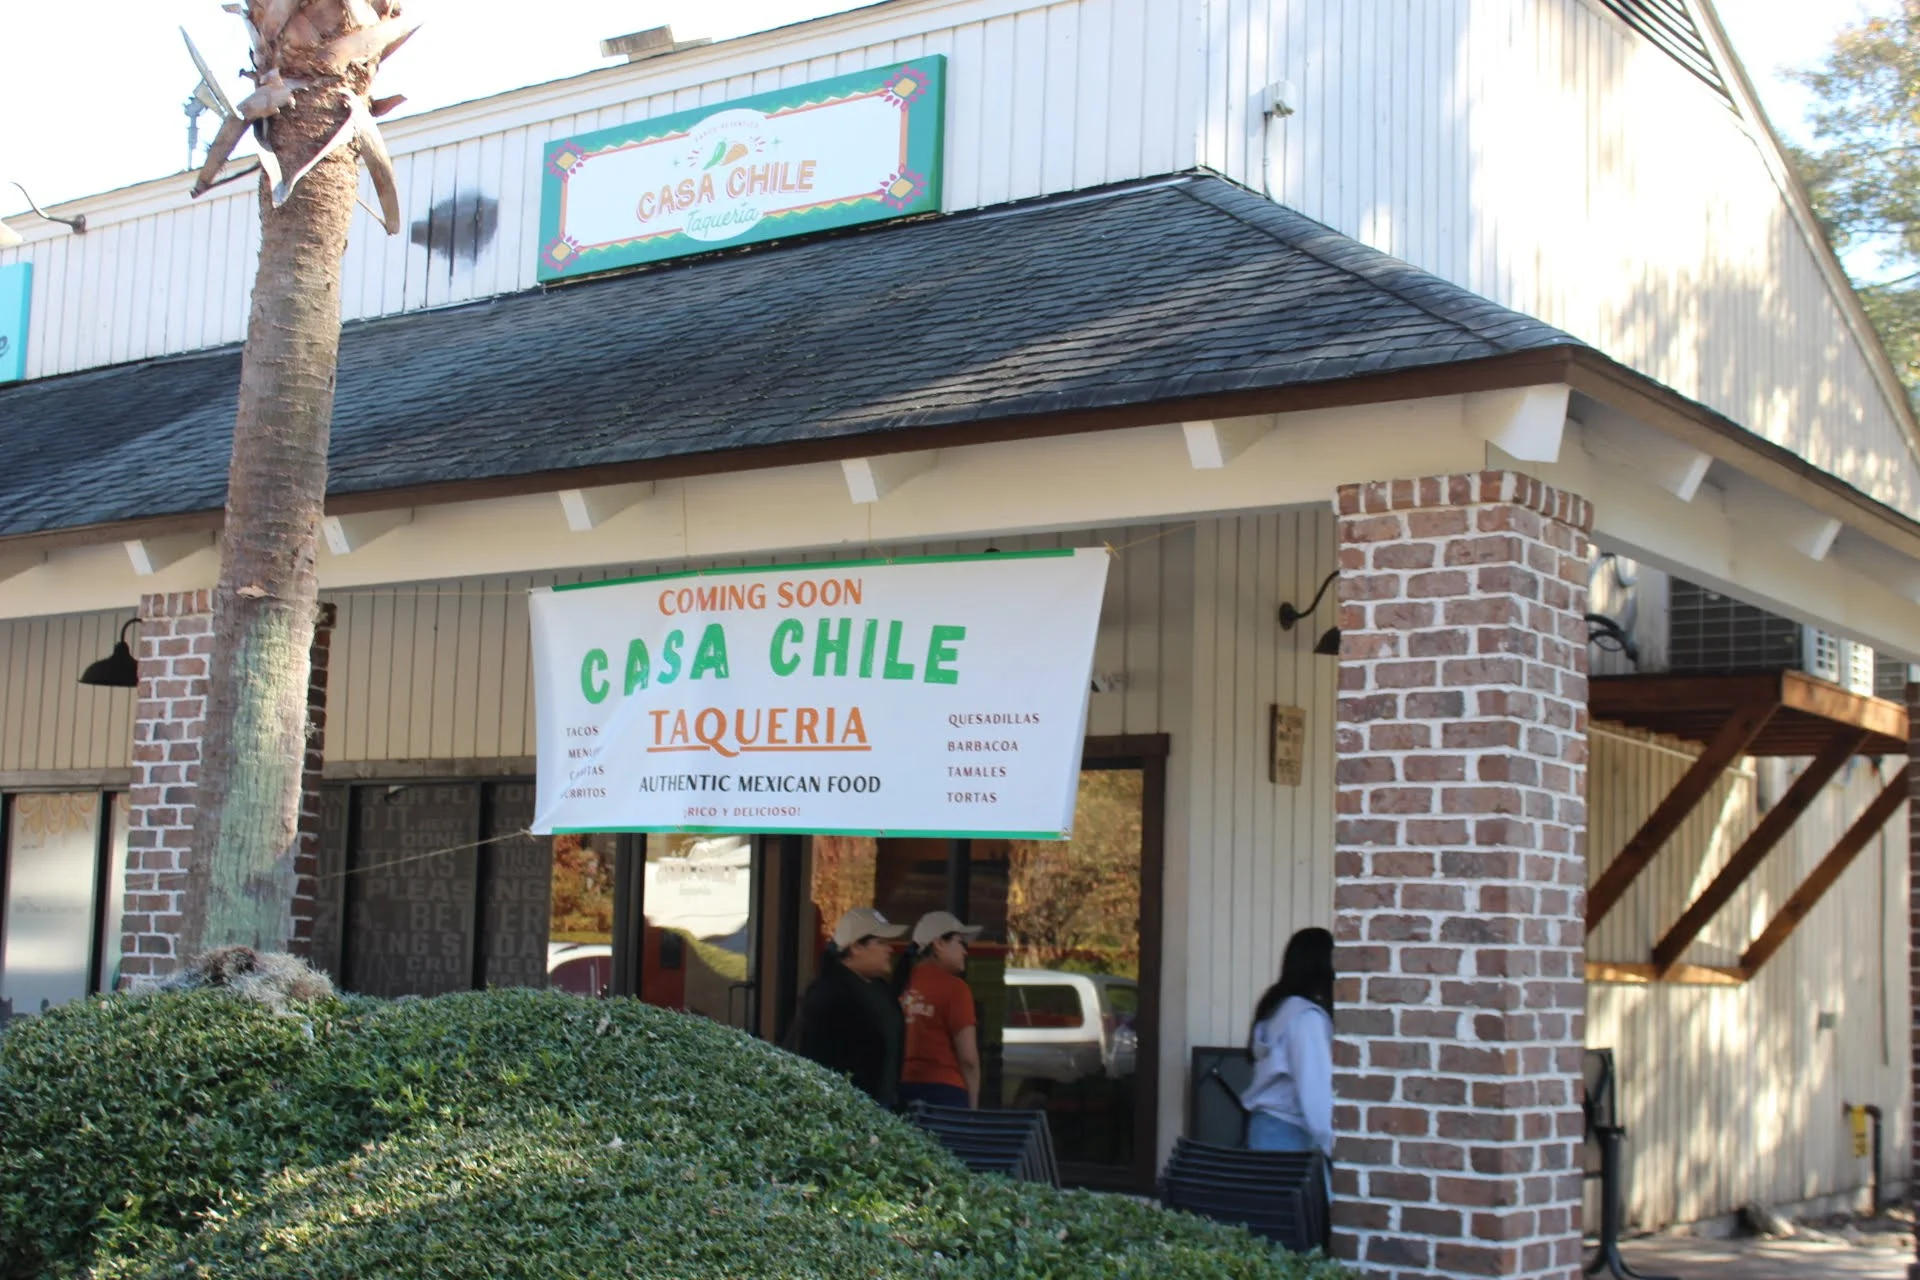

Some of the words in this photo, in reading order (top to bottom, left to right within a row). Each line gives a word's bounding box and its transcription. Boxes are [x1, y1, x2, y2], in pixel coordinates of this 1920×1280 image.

[636, 172, 716, 223] CASA
[726, 160, 817, 200] CHILE
[658, 583, 766, 616] COMING
[777, 578, 863, 609] SOON
[580, 623, 730, 704] CASA
[769, 617, 967, 685] CHILE
[948, 713, 1040, 728] QUESADILLAS
[566, 726, 600, 737] TACOS
[648, 706, 869, 758] TAQUERIA
[947, 740, 1019, 752] BARBACOA
[947, 766, 1007, 778] TAMALES
[639, 774, 732, 793] AUTHENTIC
[737, 775, 820, 793] MEXICAN
[827, 775, 881, 793] FOOD
[946, 792, 998, 803] TORTAS
[722, 807, 729, 817] Y
[733, 806, 801, 817] DELICIOSO!
